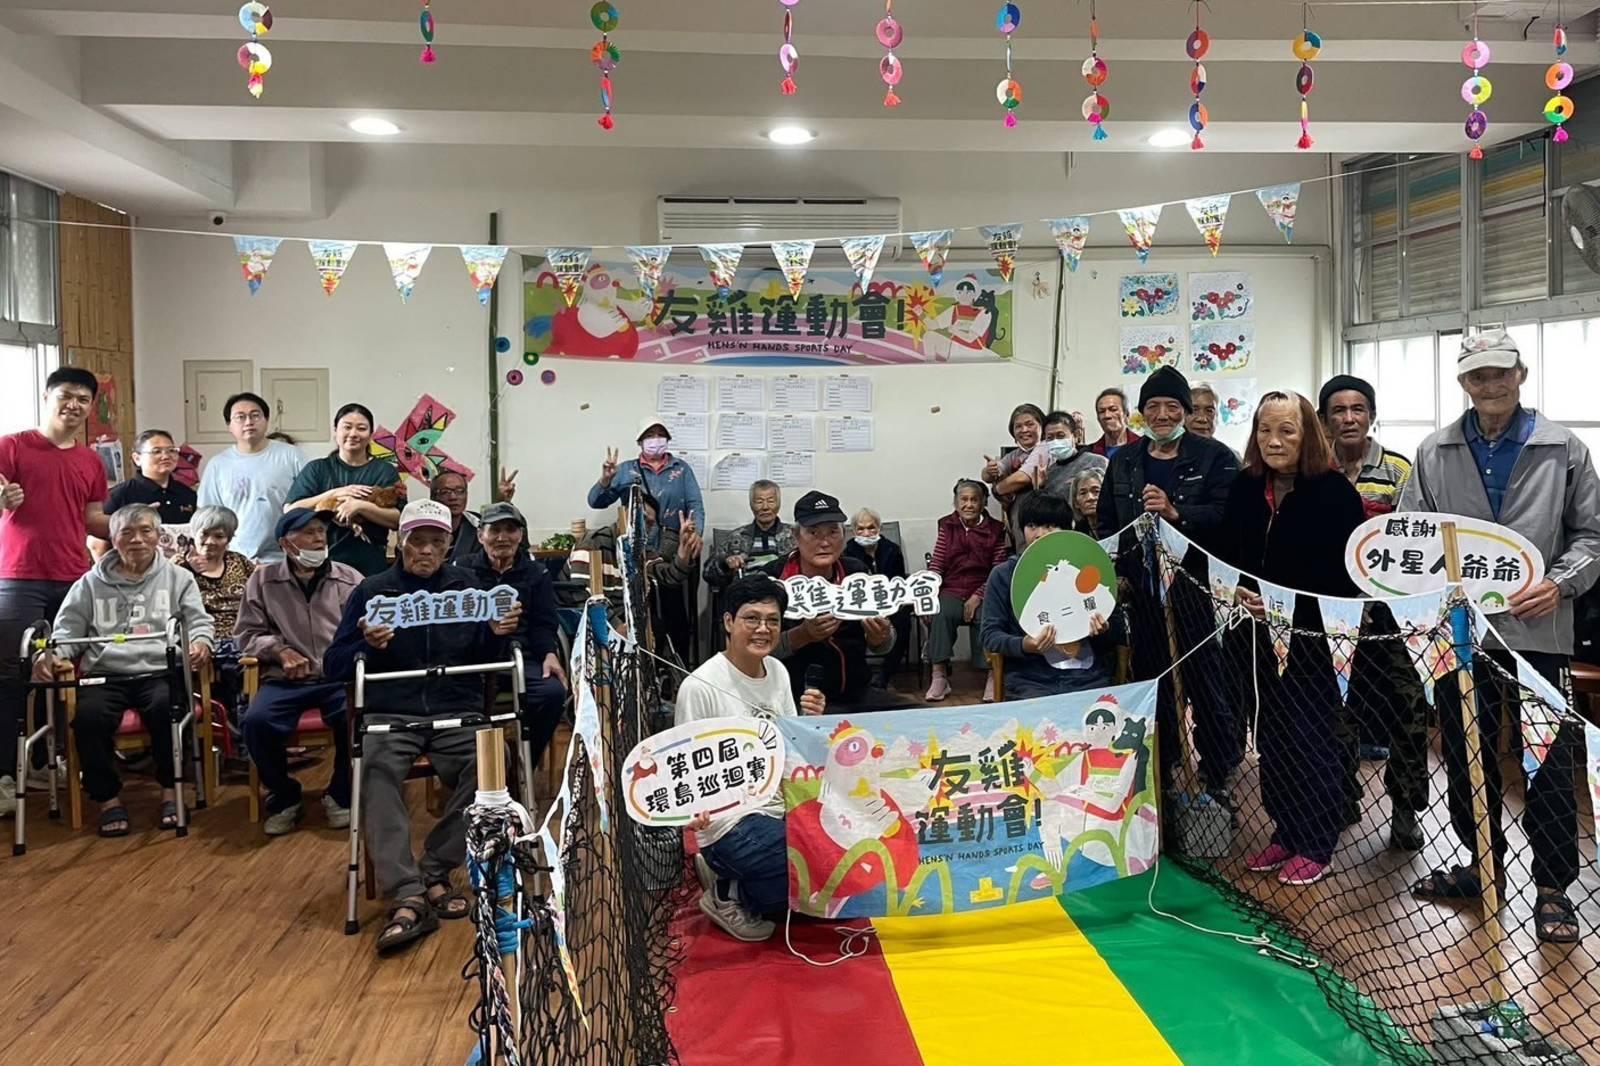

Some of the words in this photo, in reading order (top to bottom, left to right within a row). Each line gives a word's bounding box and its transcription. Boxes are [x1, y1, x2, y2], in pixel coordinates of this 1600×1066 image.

[653, 289, 905, 339] 友雞運動會!
[752, 343, 789, 352] HANDS
[794, 343, 829, 353] SPORTS
[833, 344, 853, 354] DAY
[1384, 517, 1437, 538] 感謝
[368, 588, 514, 625] 友雞運動會
[667, 737, 740, 780] 第四屆
[928, 740, 1025, 796] 友雞
[645, 756, 766, 813] 環島巡迴賽
[915, 794, 1042, 844] 運動會!
[958, 849, 991, 861] HANDS
[993, 843, 1024, 856] SPORTS
[1027, 841, 1045, 852] DAY
